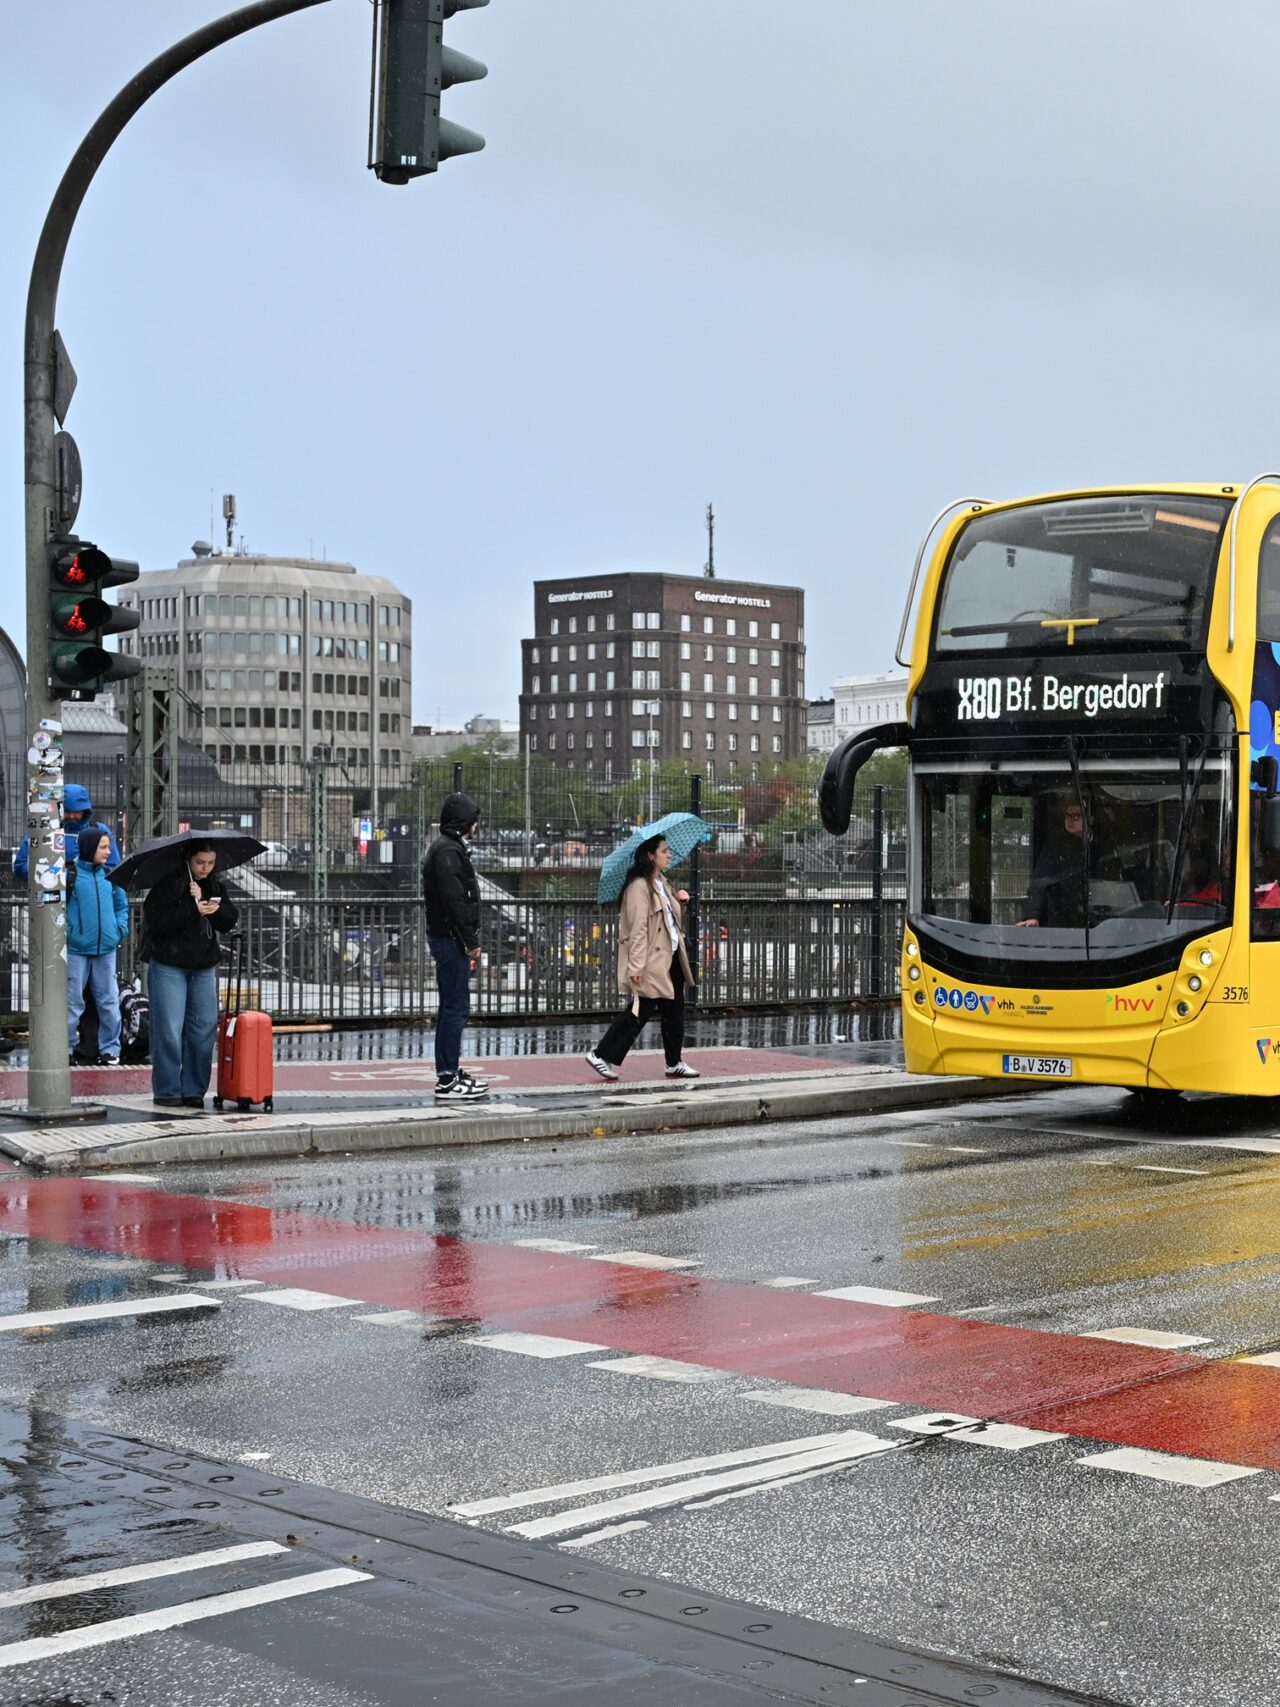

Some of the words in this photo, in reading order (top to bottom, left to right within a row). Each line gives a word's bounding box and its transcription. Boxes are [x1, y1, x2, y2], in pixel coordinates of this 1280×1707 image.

[548, 592, 583, 603] Generator
[583, 589, 614, 600] HOSTELS
[694, 590, 737, 604] Generator
[737, 596, 771, 608] HOSTELS
[957, 677, 1002, 720] X80
[1006, 676, 1037, 711] Bf.
[1043, 672, 1165, 717] Bergedorf
[1222, 986, 1249, 1000] 3576
[997, 999, 1015, 1010] vhh
[1115, 995, 1155, 1011] hvv
[1013, 1057, 1021, 1071] B
[1027, 1058, 1035, 1072] V
[1037, 1060, 1067, 1074] 3576
